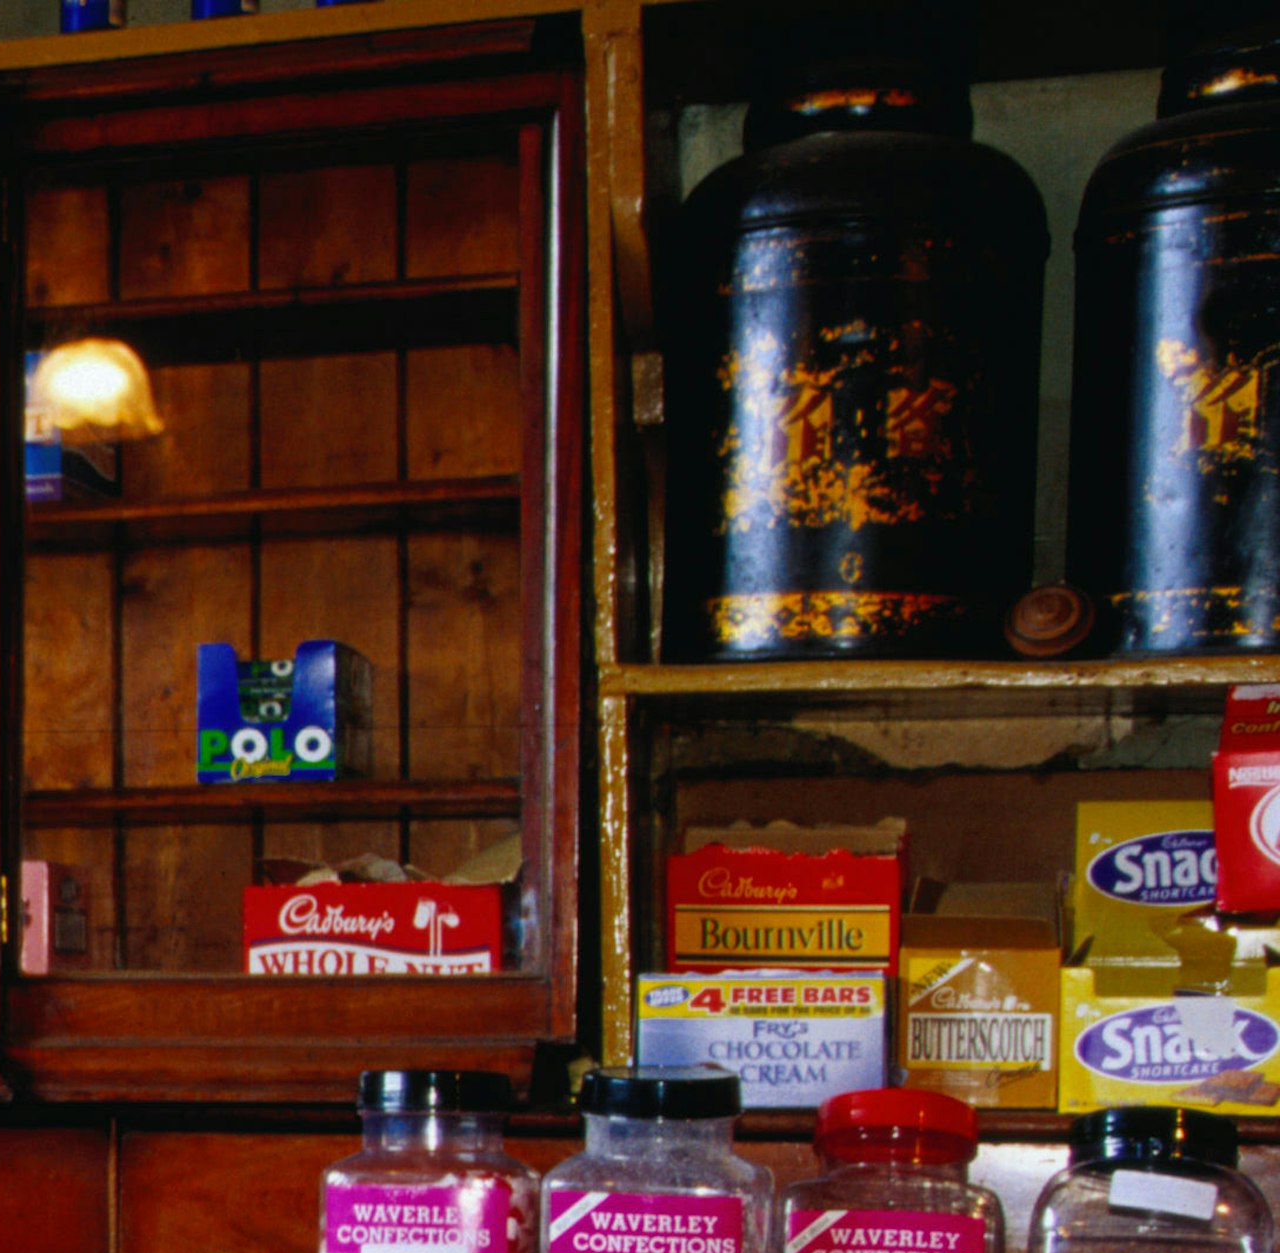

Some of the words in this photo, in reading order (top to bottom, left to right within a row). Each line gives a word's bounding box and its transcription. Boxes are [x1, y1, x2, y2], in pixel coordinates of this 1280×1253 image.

[200, 725, 333, 765] POLO
[1112, 843, 1218, 895] Snac
[698, 866, 798, 904] Cadbury's
[278, 893, 395, 941] Cadbury's
[701, 917, 864, 951] Bournville
[689, 987, 727, 1014] 4
[731, 986, 795, 1004] FREE
[803, 986, 871, 1004] BARS
[708, 1039, 863, 1061] CHOCOLATE
[910, 1016, 1046, 1062] BUTTERSCOTCH
[740, 1063, 828, 1086] CREAM
[1131, 1062, 1221, 1079] SHORTCAKE
[337, 1225, 491, 1247] CONFECTIONS
[590, 1211, 718, 1235] WAVERLEY
[829, 1228, 961, 1250] WAVERLEY
